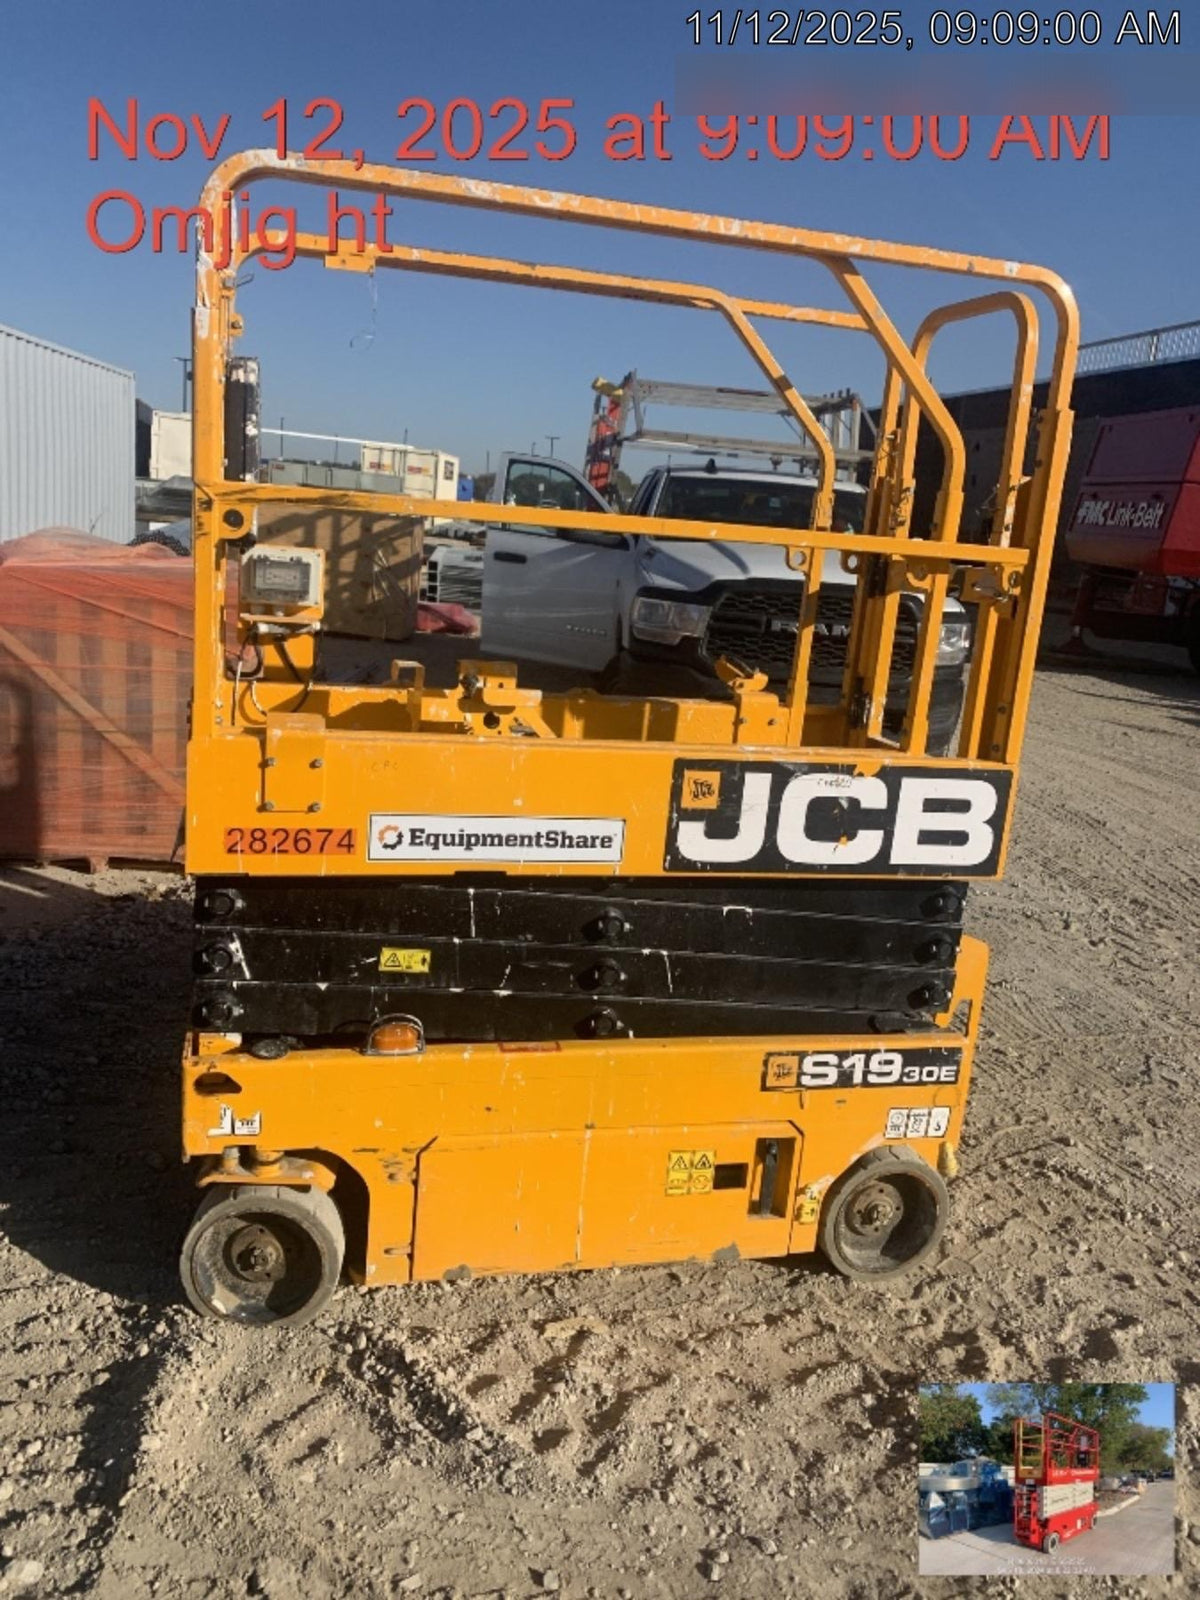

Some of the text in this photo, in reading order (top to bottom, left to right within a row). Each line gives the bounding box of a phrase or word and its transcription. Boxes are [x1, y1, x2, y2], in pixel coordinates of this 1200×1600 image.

[1106, 500, 1165, 529] Link-Belt
[676, 771, 998, 867] JCB
[226, 827, 356, 854] 282674
[408, 827, 613, 849] EquipmentShare
